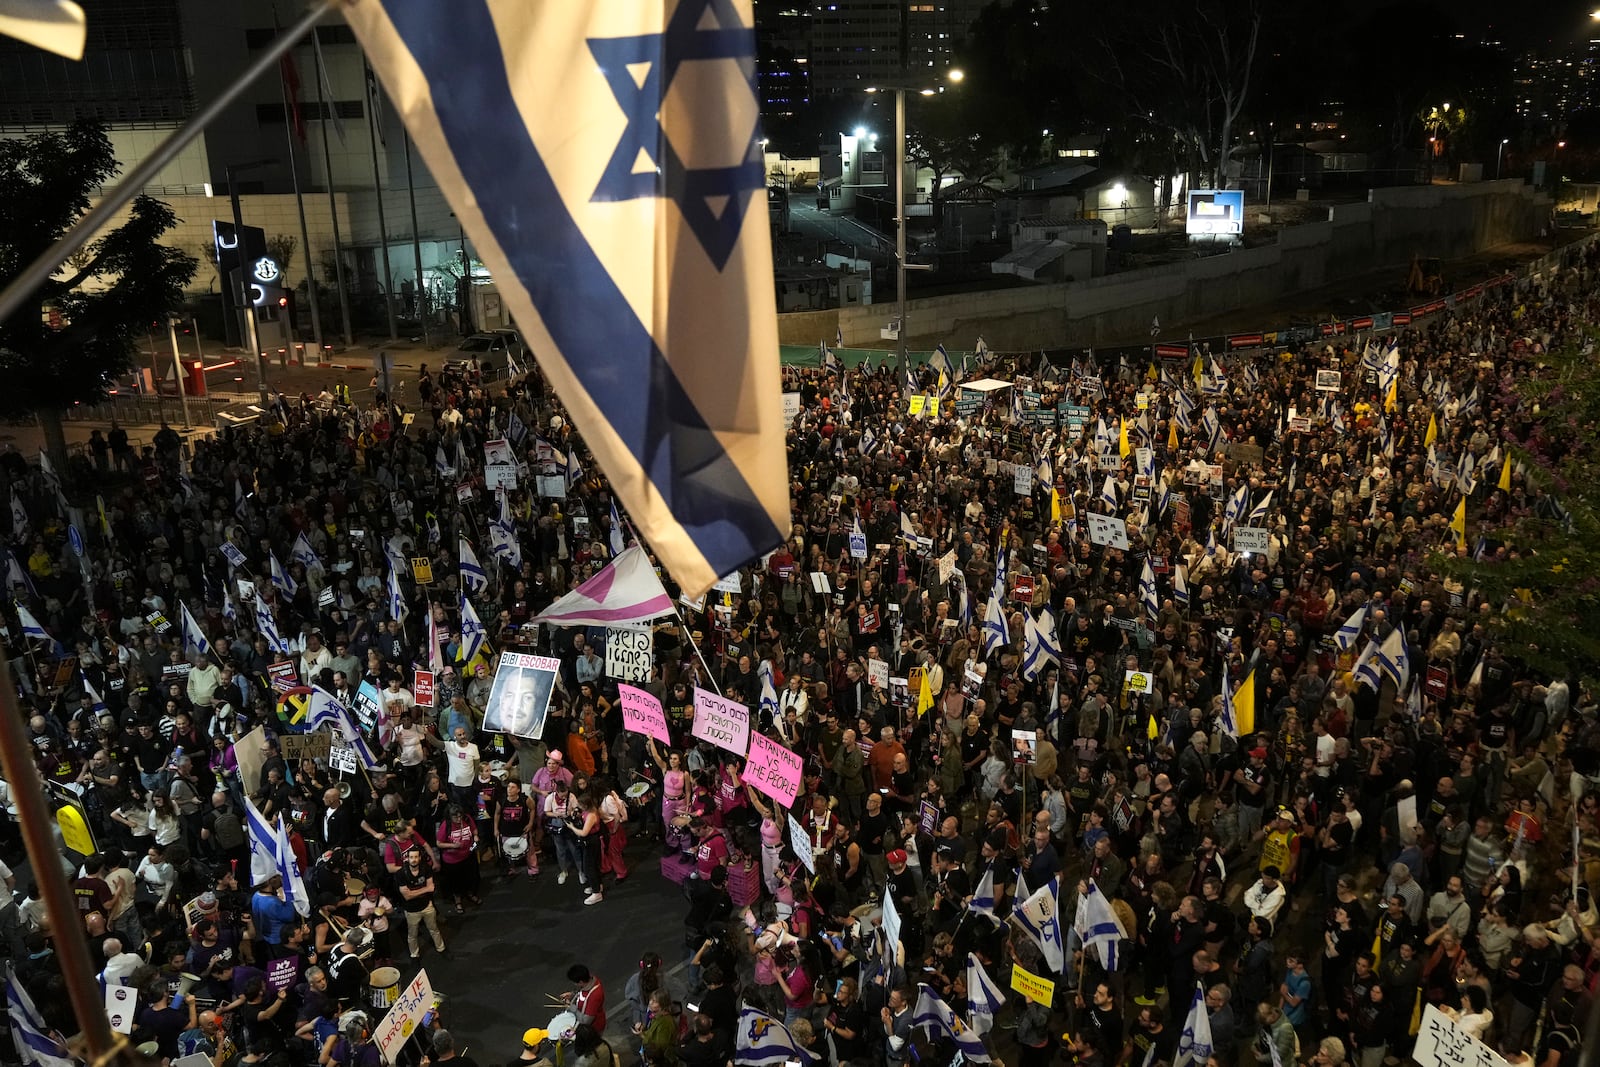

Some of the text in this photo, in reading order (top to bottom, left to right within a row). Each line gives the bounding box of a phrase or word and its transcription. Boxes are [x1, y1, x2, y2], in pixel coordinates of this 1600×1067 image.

[1101, 457, 1116, 466] 414
[1017, 467, 1031, 478] 101
[413, 559, 429, 568] 7.10
[607, 627, 650, 650] פושעים
[501, 653, 559, 671] BIBI ESCOBAR
[609, 646, 651, 668] השתלטו
[621, 691, 643, 703] תודעה
[624, 707, 646, 722] עסקה
[752, 733, 801, 770] NETANYAHU
[748, 760, 797, 798] THE PEOPLE
[276, 961, 290, 971] לא
[1019, 980, 1044, 997] הביתה
[388, 975, 424, 1025] אין צדיק
[409, 987, 426, 1012] אחד
